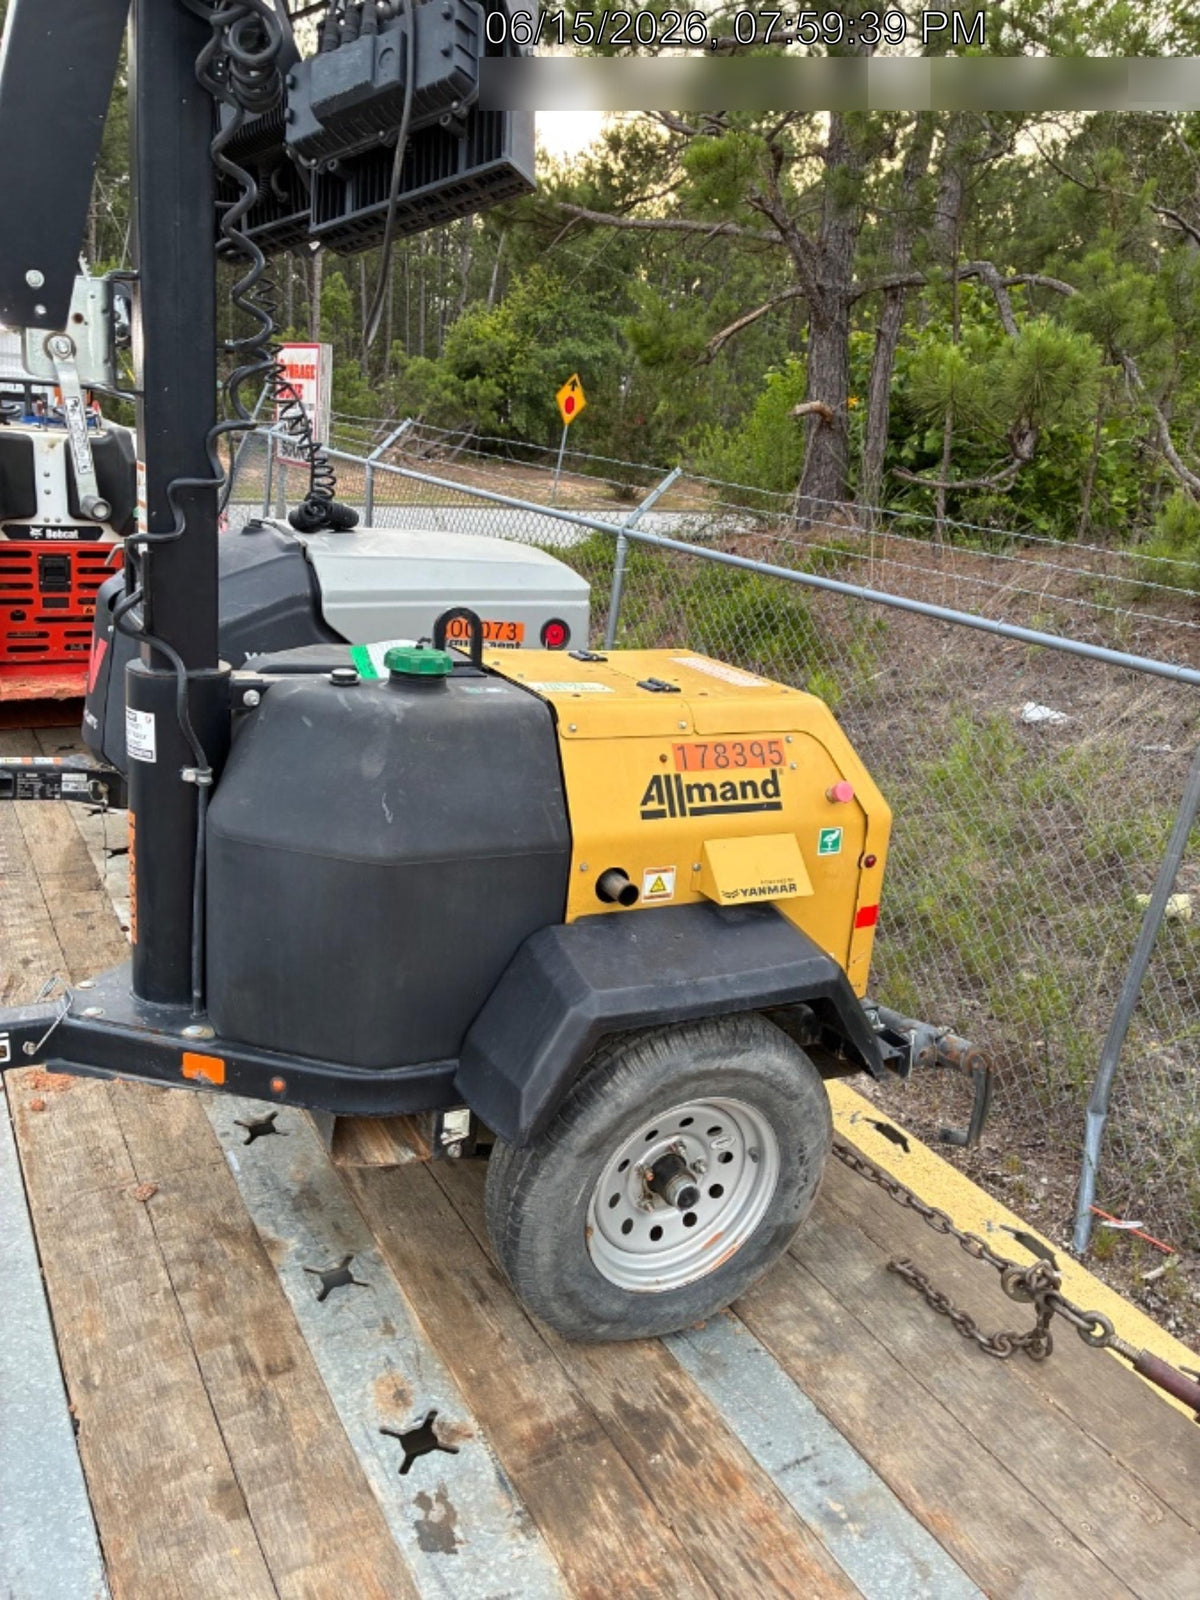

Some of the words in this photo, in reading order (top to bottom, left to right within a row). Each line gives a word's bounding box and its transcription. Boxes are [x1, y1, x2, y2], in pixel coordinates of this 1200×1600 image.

[45, 528, 79, 539] Bobcat
[677, 740, 783, 770] 178395
[640, 768, 782, 818] Allmand
[740, 883, 797, 897] YANMAR
